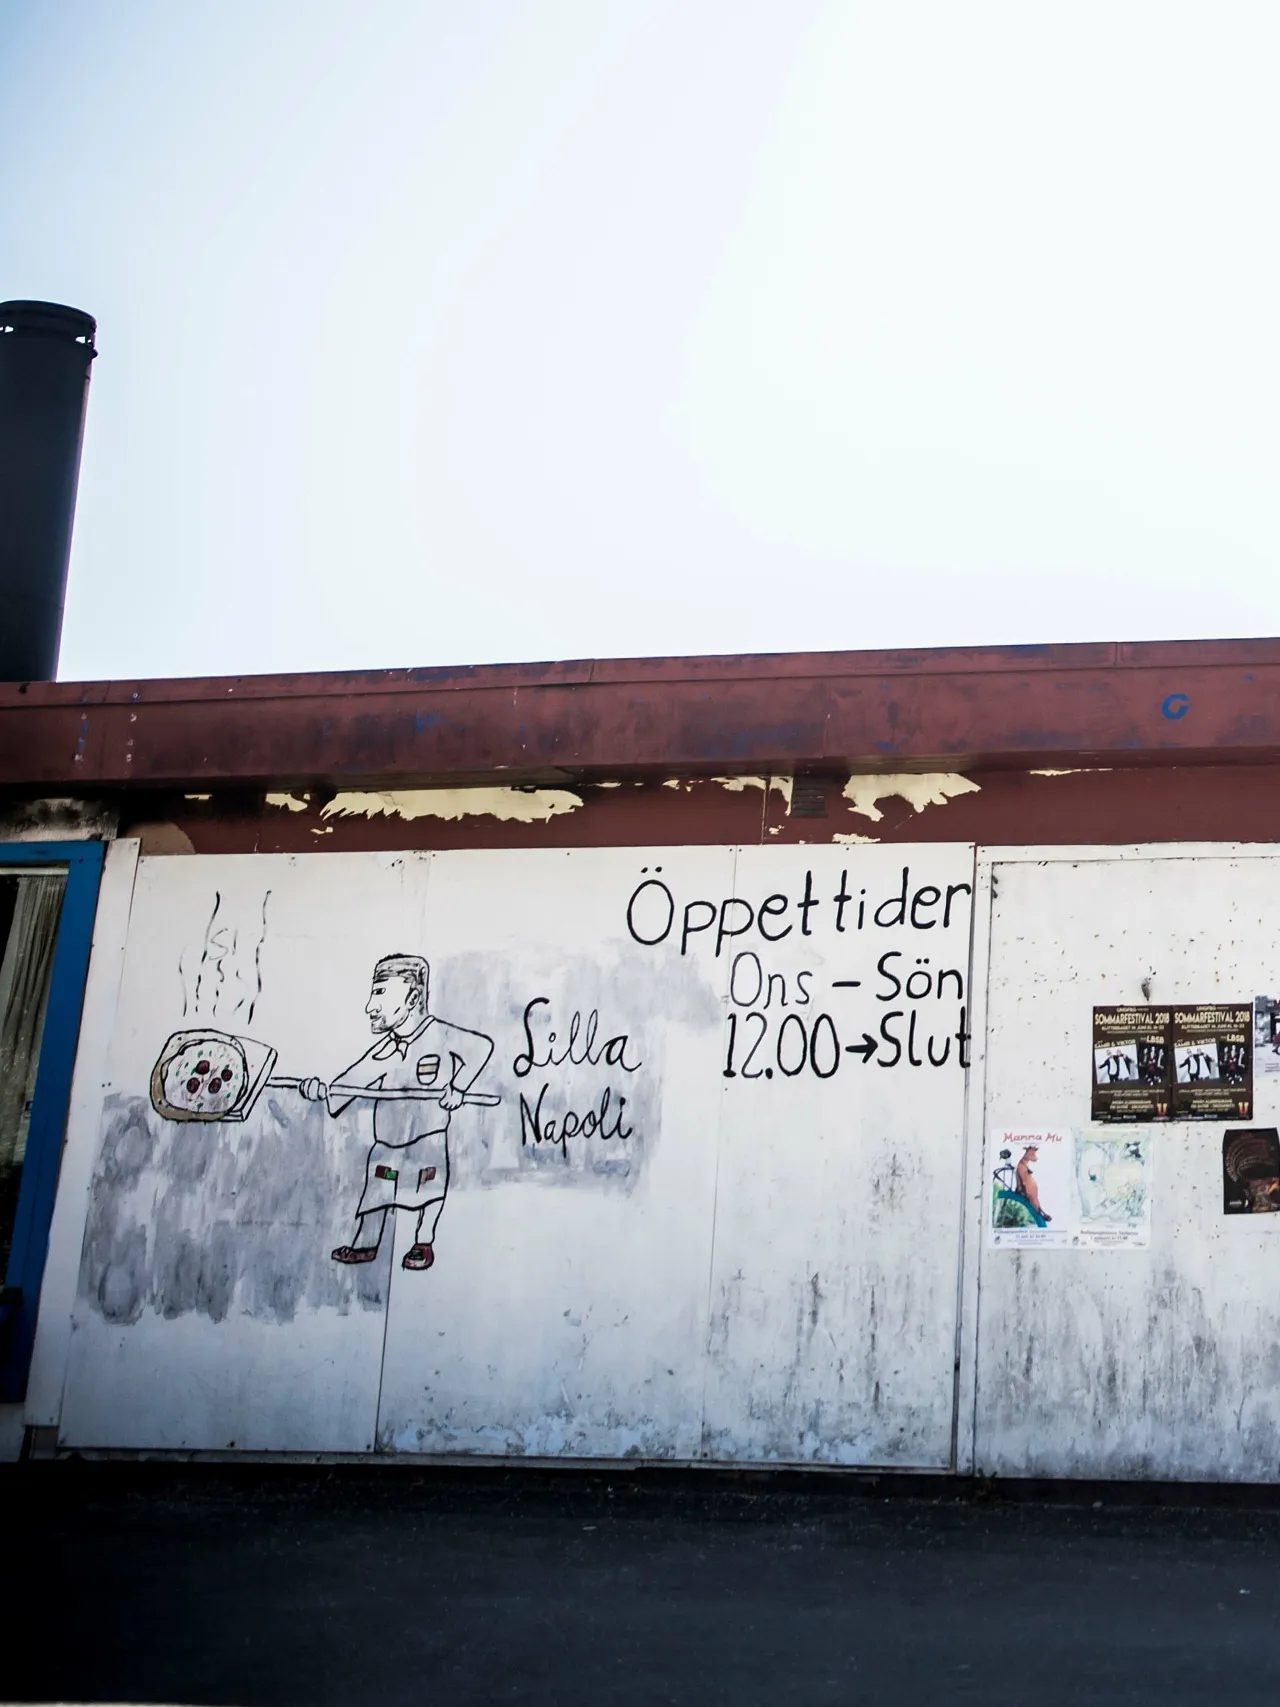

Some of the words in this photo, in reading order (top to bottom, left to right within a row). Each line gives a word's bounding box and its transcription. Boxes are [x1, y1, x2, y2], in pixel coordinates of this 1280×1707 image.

[626, 866, 972, 957] Öppettider
[729, 951, 813, 1010] Ons
[875, 950, 964, 1001] Sön
[513, 997, 642, 1077] Lilla
[722, 1011, 841, 1079] 12.00
[876, 1006, 972, 1069] Slut
[1094, 1012, 1154, 1025] SOMMARFESTIVAL
[1155, 1012, 1170, 1024] 2018
[1174, 1011, 1234, 1024] SOMMARFESTIVAL
[1235, 1010, 1250, 1023] 2018
[520, 1083, 633, 1158] Napoli
[1003, 1132, 1042, 1143] Mamma
[1045, 1131, 1063, 1143] Mu
